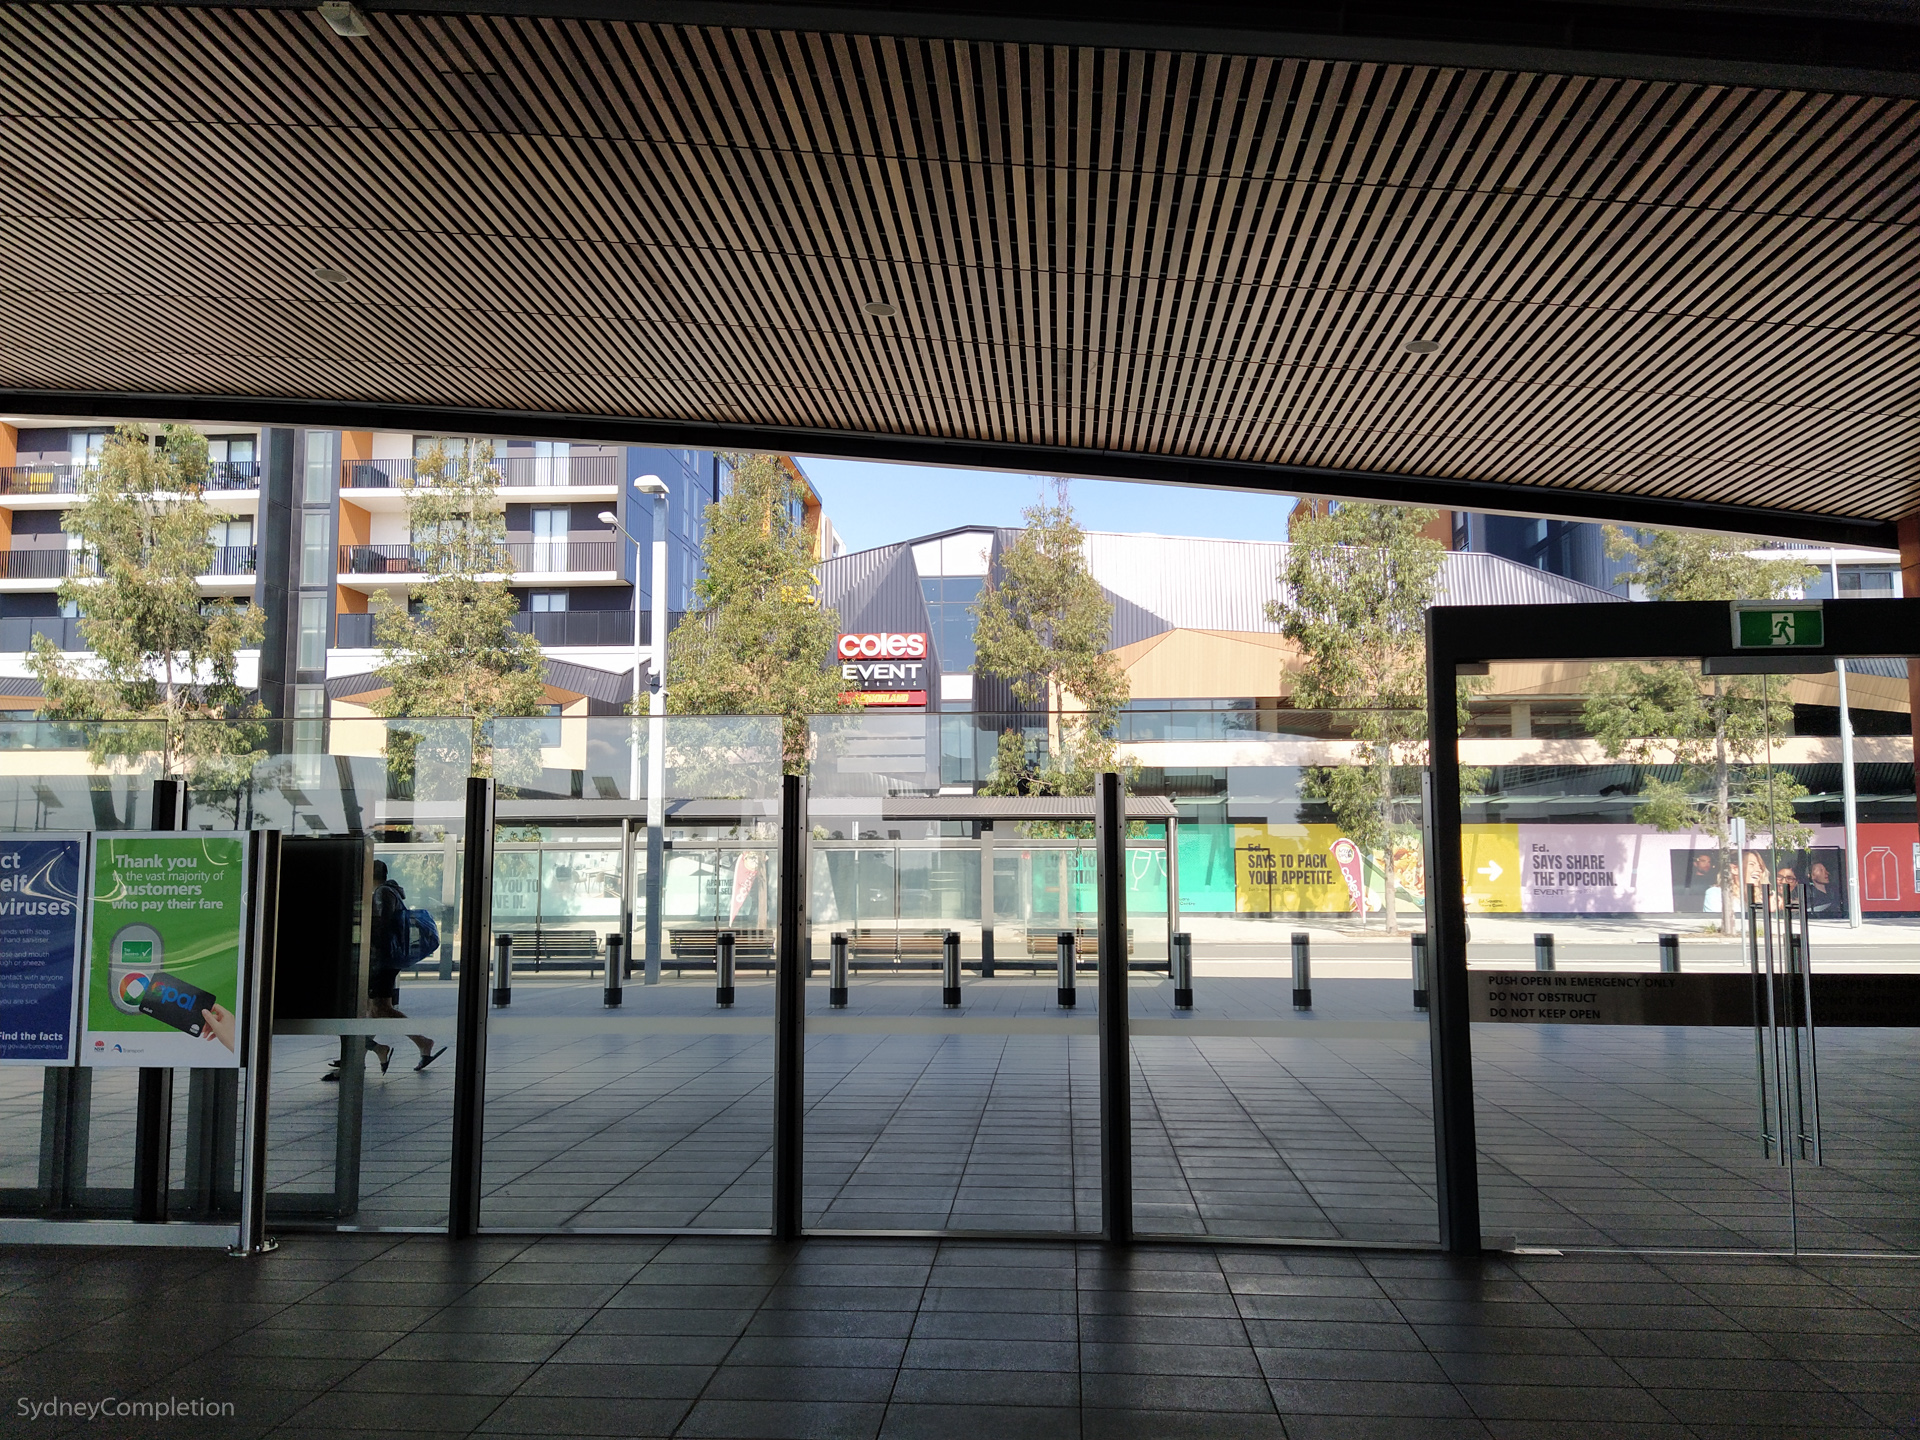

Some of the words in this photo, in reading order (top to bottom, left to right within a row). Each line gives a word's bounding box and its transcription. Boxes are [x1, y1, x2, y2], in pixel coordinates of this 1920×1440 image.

[839, 633, 924, 657] coles
[842, 664, 922, 680] EVENT
[1532, 843, 1550, 852] Ed.
[115, 854, 163, 868] Thank
[167, 856, 197, 871] you
[1248, 854, 1276, 868] SAYS
[1280, 854, 1293, 868] TO
[1298, 854, 1327, 868] PACK
[1533, 855, 1562, 869] SAYS
[1567, 855, 1605, 869] SHARE
[112, 872, 123, 881] to
[126, 871, 142, 881] the
[146, 872, 165, 881] vast
[168, 871, 210, 883] majority
[213, 870, 224, 881] of
[1249, 871, 1277, 884] YOUR
[1282, 870, 1336, 885] APPETITE.
[1341, 867, 1361, 898] coles
[1533, 871, 1554, 886] THE
[1559, 871, 1617, 886] POPCORN.
[121, 883, 202, 896] customers
[0, 898, 71, 915] viruses
[112, 899, 138, 909] who
[142, 900, 164, 912] pay
[167, 899, 196, 909] their
[199, 899, 223, 909] fare
[1489, 976, 1517, 985] PUSH
[1521, 976, 1551, 986] OPEN
[1555, 977, 1567, 986] IN
[1571, 977, 1641, 987] EMERGENCY
[1644, 978, 1675, 987] ONLY
[151, 981, 197, 1011] opal
[1489, 992, 1506, 1001] DO
[1511, 992, 1534, 1001] NOT
[1538, 993, 1597, 1003] OBSTRUCT
[1490, 1008, 1507, 1017] DO
[1511, 1008, 1535, 1017] NOT
[1539, 1009, 1566, 1018] KEEP
[1570, 1009, 1600, 1019] OPEN
[20, 1031, 37, 1040] the
[39, 1031, 63, 1041] facts
